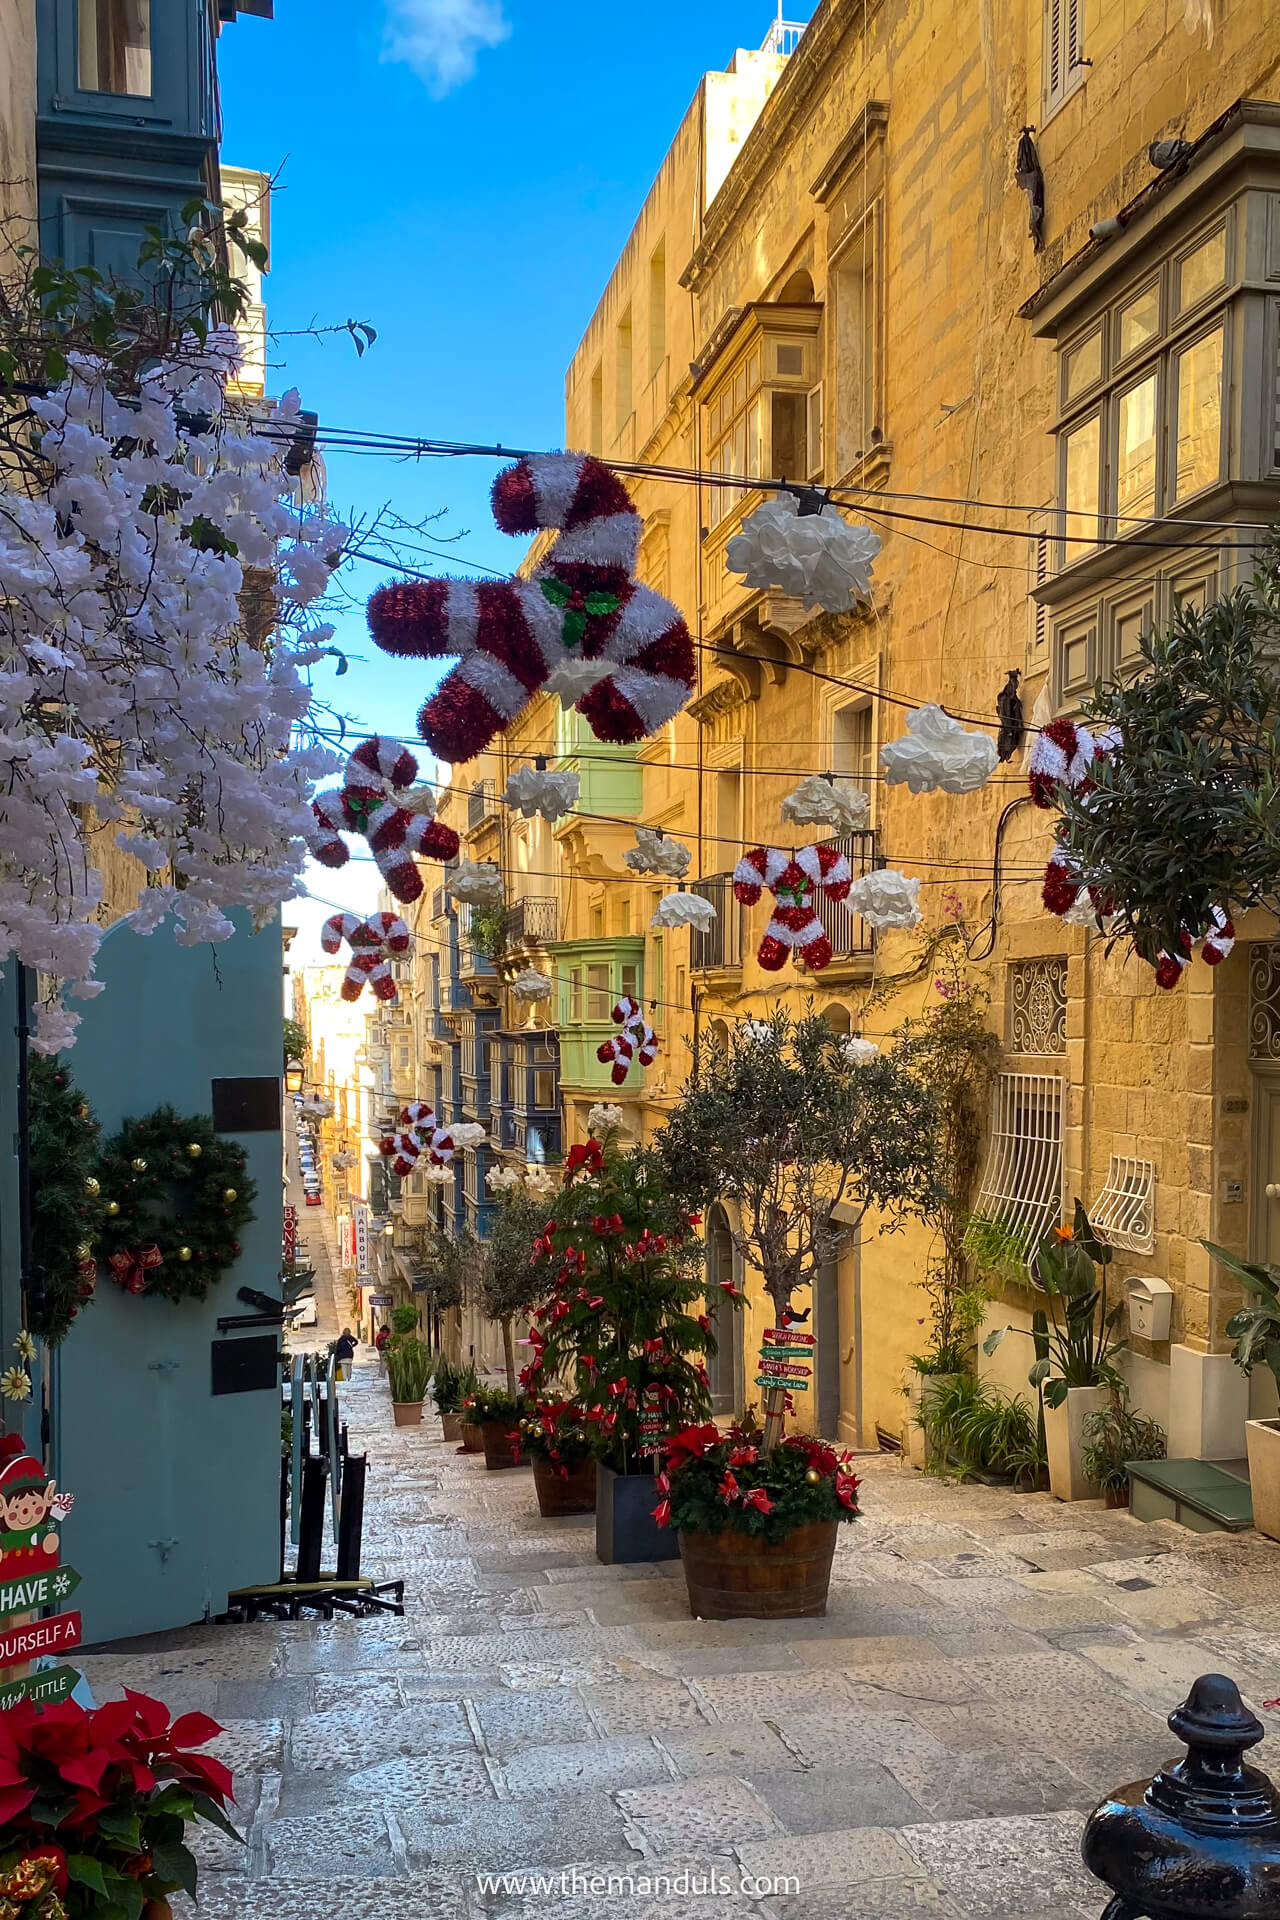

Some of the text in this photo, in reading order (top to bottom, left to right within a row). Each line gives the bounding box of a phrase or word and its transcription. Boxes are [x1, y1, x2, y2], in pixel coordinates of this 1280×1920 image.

[358, 1209, 366, 1270] HARBOUR
[757, 1377, 776, 1388] Candy
[777, 1379, 792, 1387] Cane
[0, 1577, 48, 1612] HAVE
[64, 1621, 76, 1639] A
[29, 1676, 67, 1701] LITTLE
